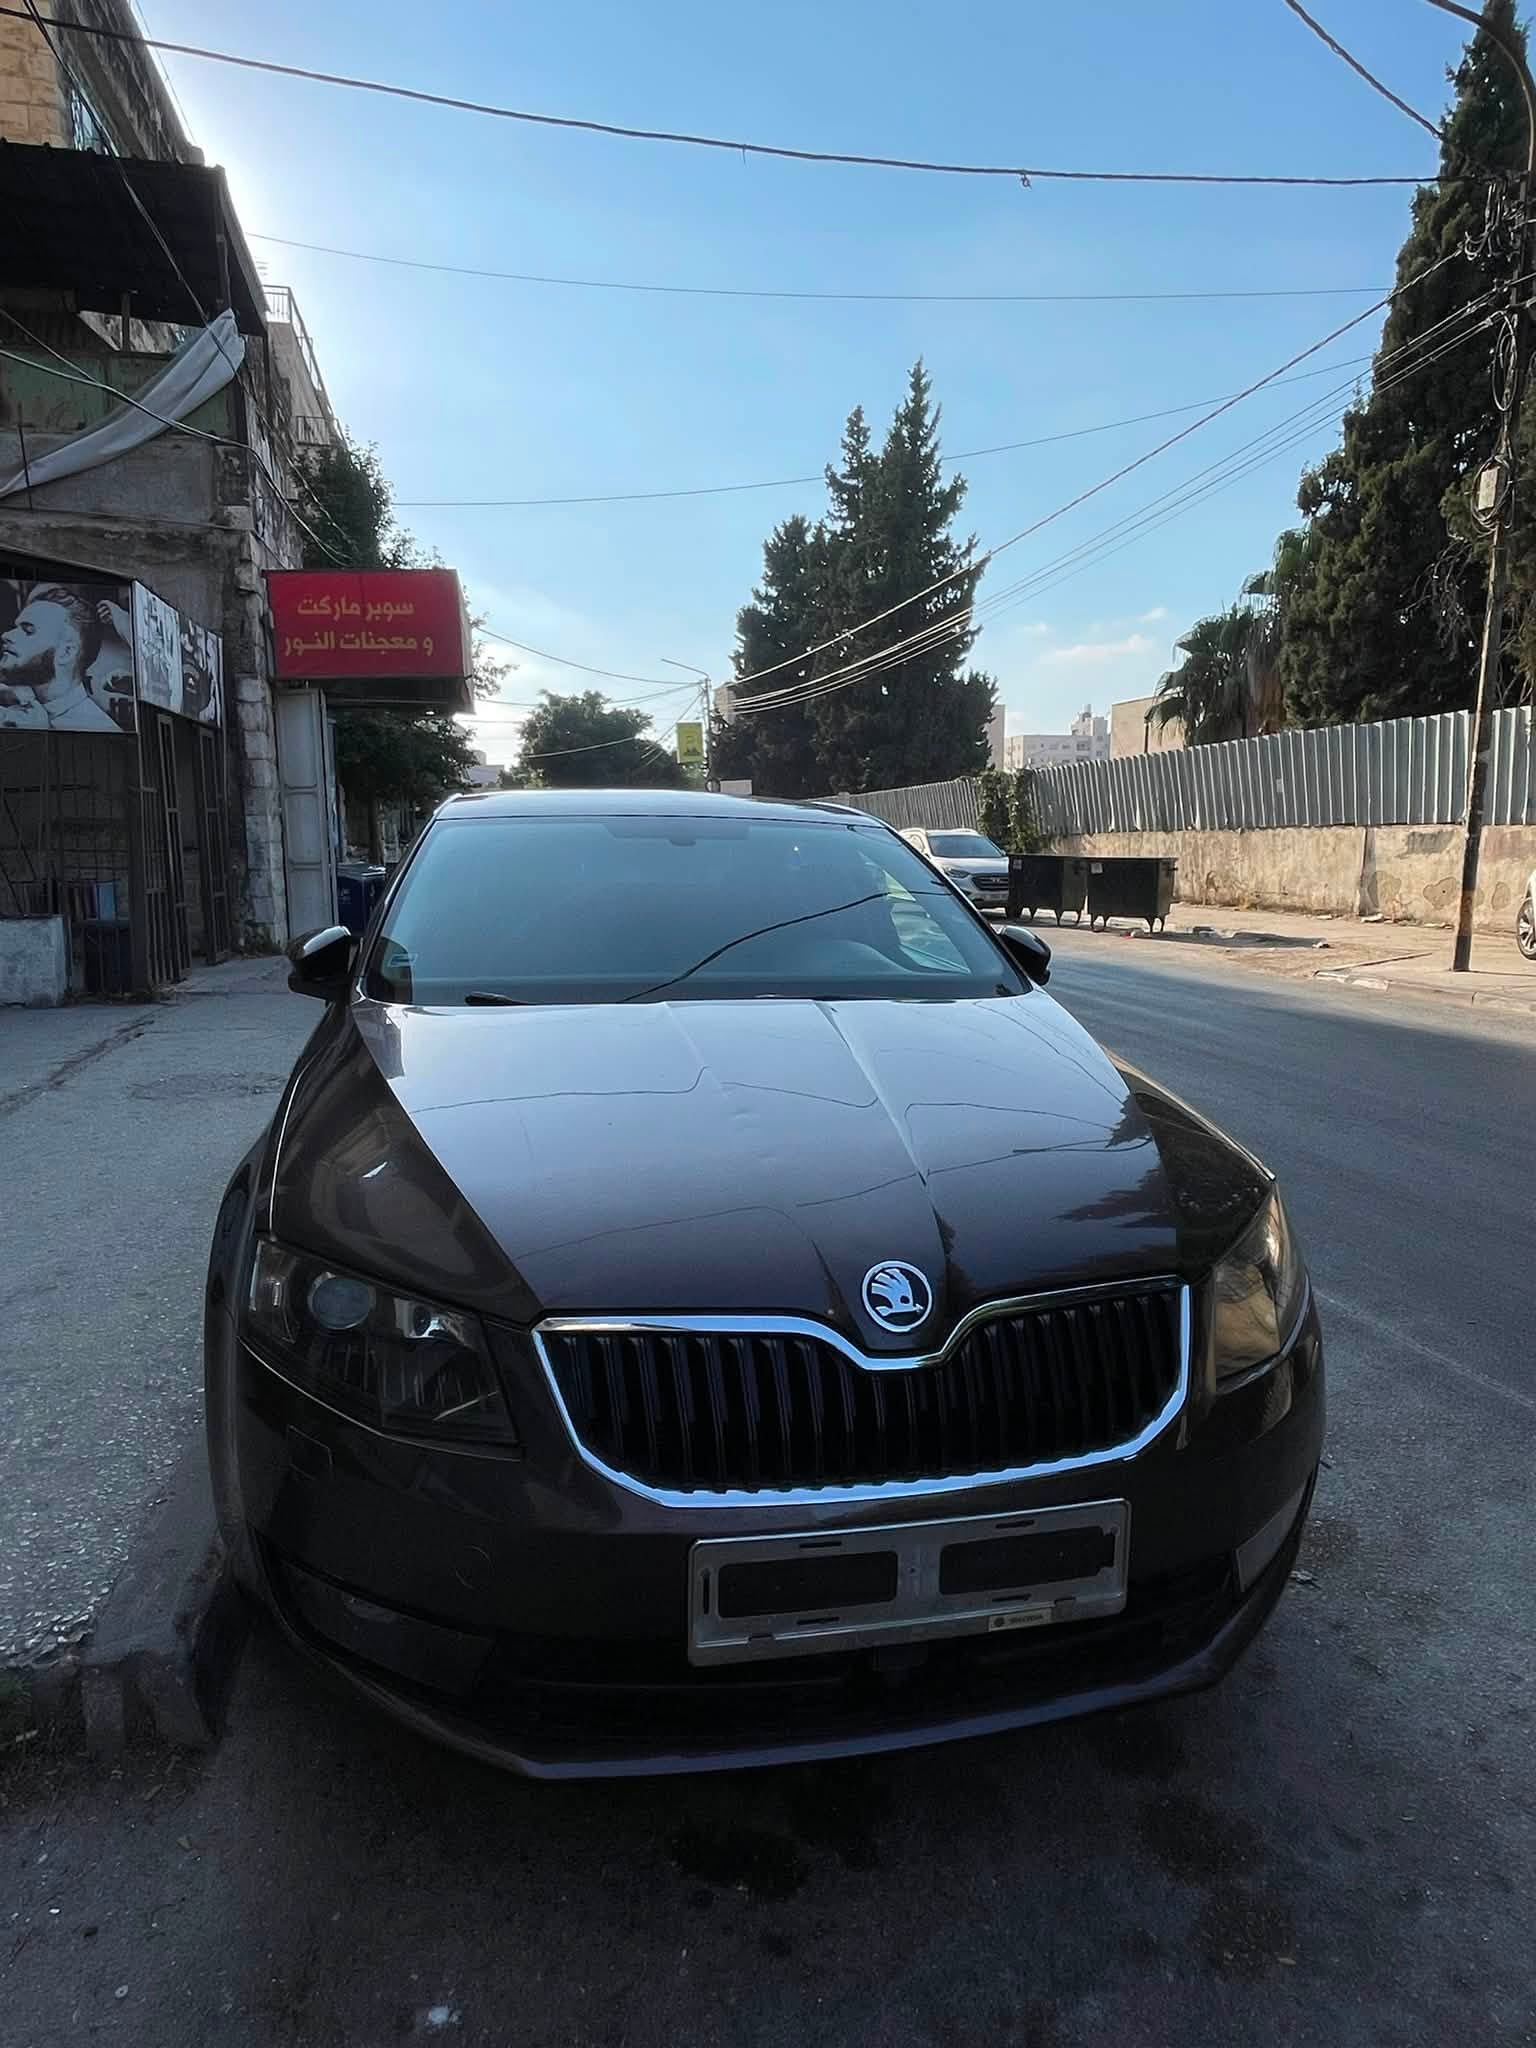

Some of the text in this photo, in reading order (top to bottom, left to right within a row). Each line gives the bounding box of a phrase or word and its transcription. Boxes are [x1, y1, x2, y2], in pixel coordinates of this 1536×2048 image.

[297, 595, 415, 622] سوبر ماركت
[285, 631, 433, 656] و معجنات النور
